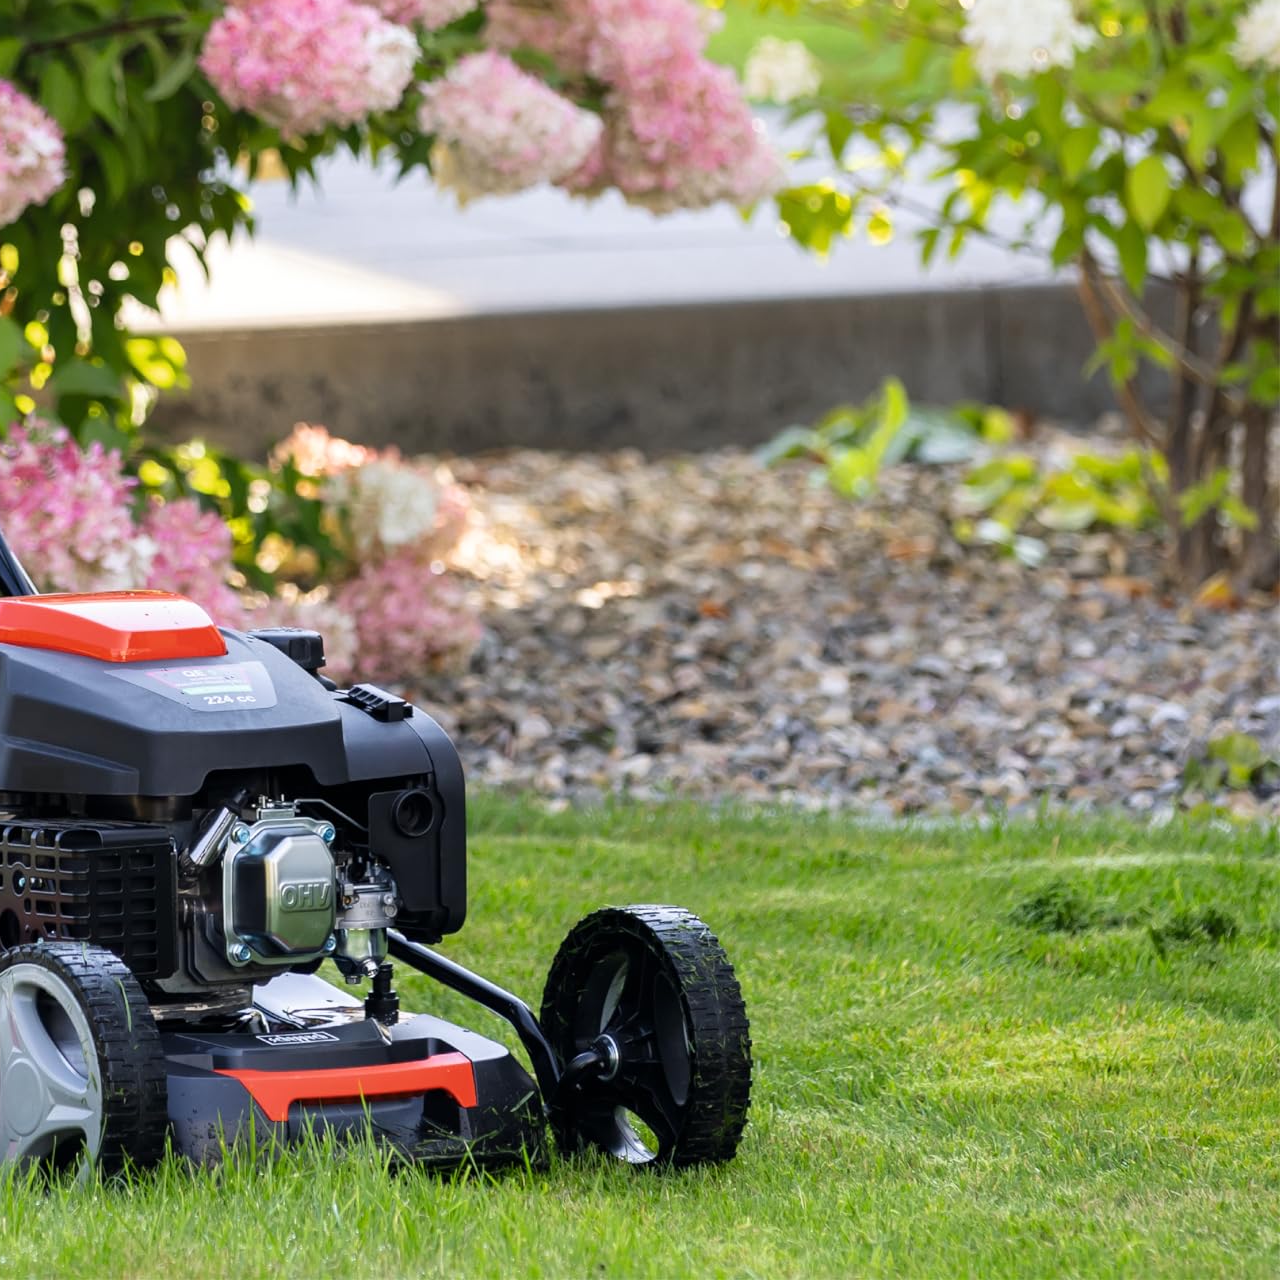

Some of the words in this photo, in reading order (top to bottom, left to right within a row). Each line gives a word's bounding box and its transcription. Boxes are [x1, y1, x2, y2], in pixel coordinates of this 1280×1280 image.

[203, 695, 234, 705] 224
[236, 695, 257, 703] cc
[281, 883, 330, 909] OHV
